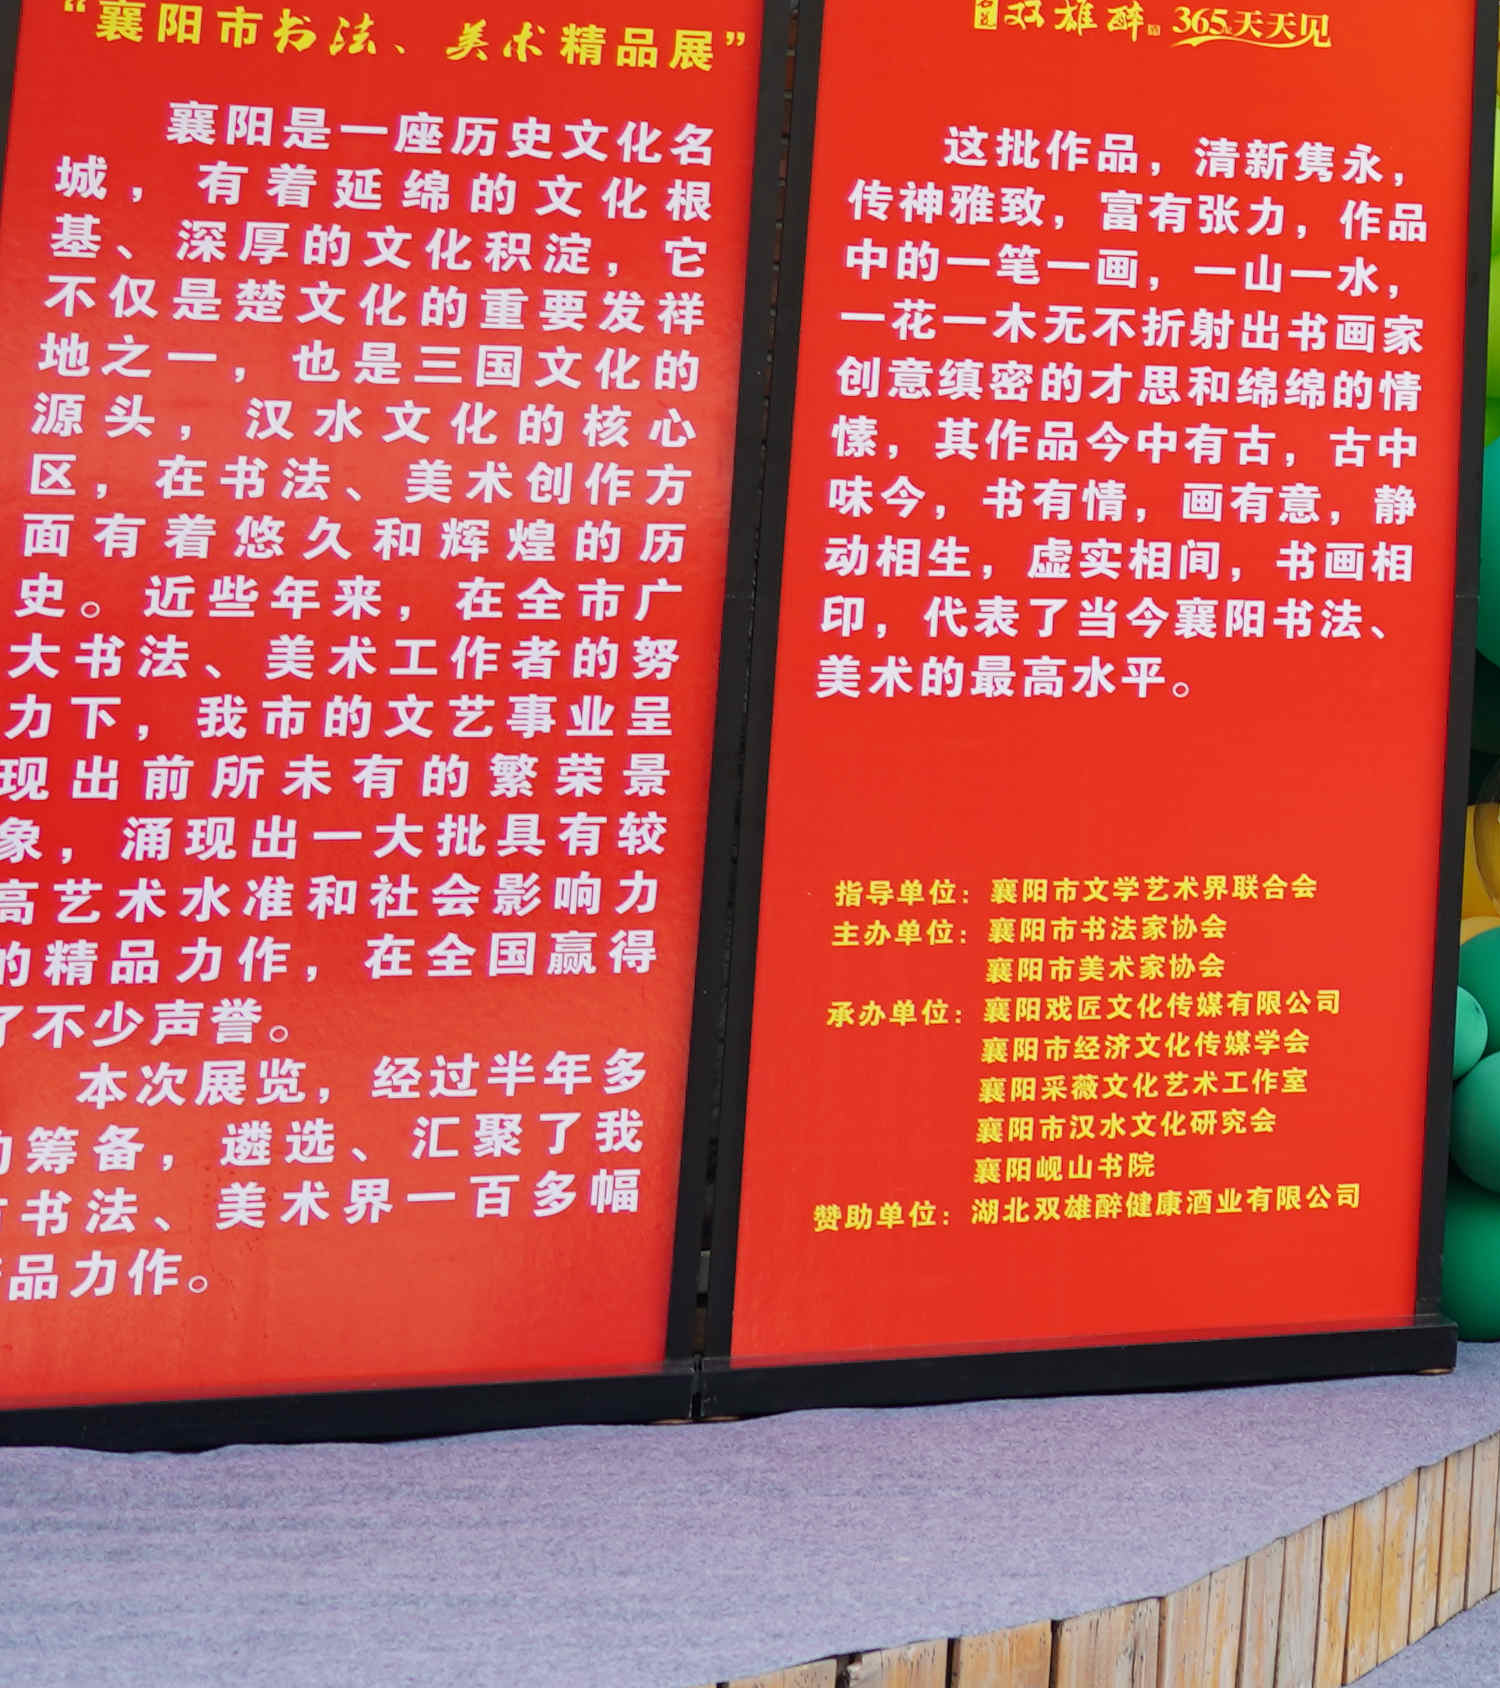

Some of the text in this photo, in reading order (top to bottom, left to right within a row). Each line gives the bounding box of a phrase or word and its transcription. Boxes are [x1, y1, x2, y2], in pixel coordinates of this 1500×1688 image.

[165, 100, 714, 167] 襄阳是一座历史文化名
[943, 125, 1404, 187] 这批作品，清新隽永，
[54, 154, 712, 222] 城，有着延绵的文化根
[847, 178, 1428, 243] 传神雅致，富有张力，作品
[49, 212, 708, 278] 基、深厚的文化积淀，它
[845, 237, 1399, 300] 中的一笔一画，一山一水，
[43, 273, 705, 336] 不仅是楚文化的重要发祥
[840, 297, 1424, 356] 一花一木无不折射出书画家
[37, 331, 700, 393] 地之一，也是三国文化的
[836, 355, 1422, 412] 创意缜密的才思和绵绵的情
[30, 391, 697, 449] 源头，汉水文化的核心
[830, 414, 1418, 469] 愫，其作品今中有古，古中
[29, 452, 693, 507] 区，在书法、美术创作方
[828, 474, 1417, 526] 味今，书有情，画有意，静
[23, 512, 687, 564] 面有着悠久和辉煌的历
[823, 533, 1413, 583] 动相生，虚实相间，书画相
[14, 571, 683, 622] 史。近些年来，在全市广
[820, 594, 1385, 640] 印，代表了当今襄阳书法、
[7, 632, 680, 681] 大书法、美术工作者的努
[815, 654, 1190, 699] 美术的最高水平。
[4, 693, 673, 742] 力下，我市的文艺事业呈
[0, 752, 671, 802] 现出前所未有的繁荣景
[0, 810, 668, 865] 象，涌现出一大批具有较
[0, 869, 658, 926] 高艺术水准和社会影响力
[985, 952, 1225, 985] 襄阳市美术家协会
[980, 1027, 1310, 1065] 襄阳市经济文化传媒学会
[75, 1047, 647, 1111] 本次展览，经过半年多
[978, 1066, 1308, 1105] 襄阳采薇文化艺术工作室
[0, 1107, 644, 1176] 筹备，遴选、汇聚了我
[975, 1106, 1277, 1145] 襄阳市汉水文化研究会
[973, 1150, 1155, 1185] 襄阳岘山书院
[0, 1168, 641, 1238] 书法、美术界一百多幅
